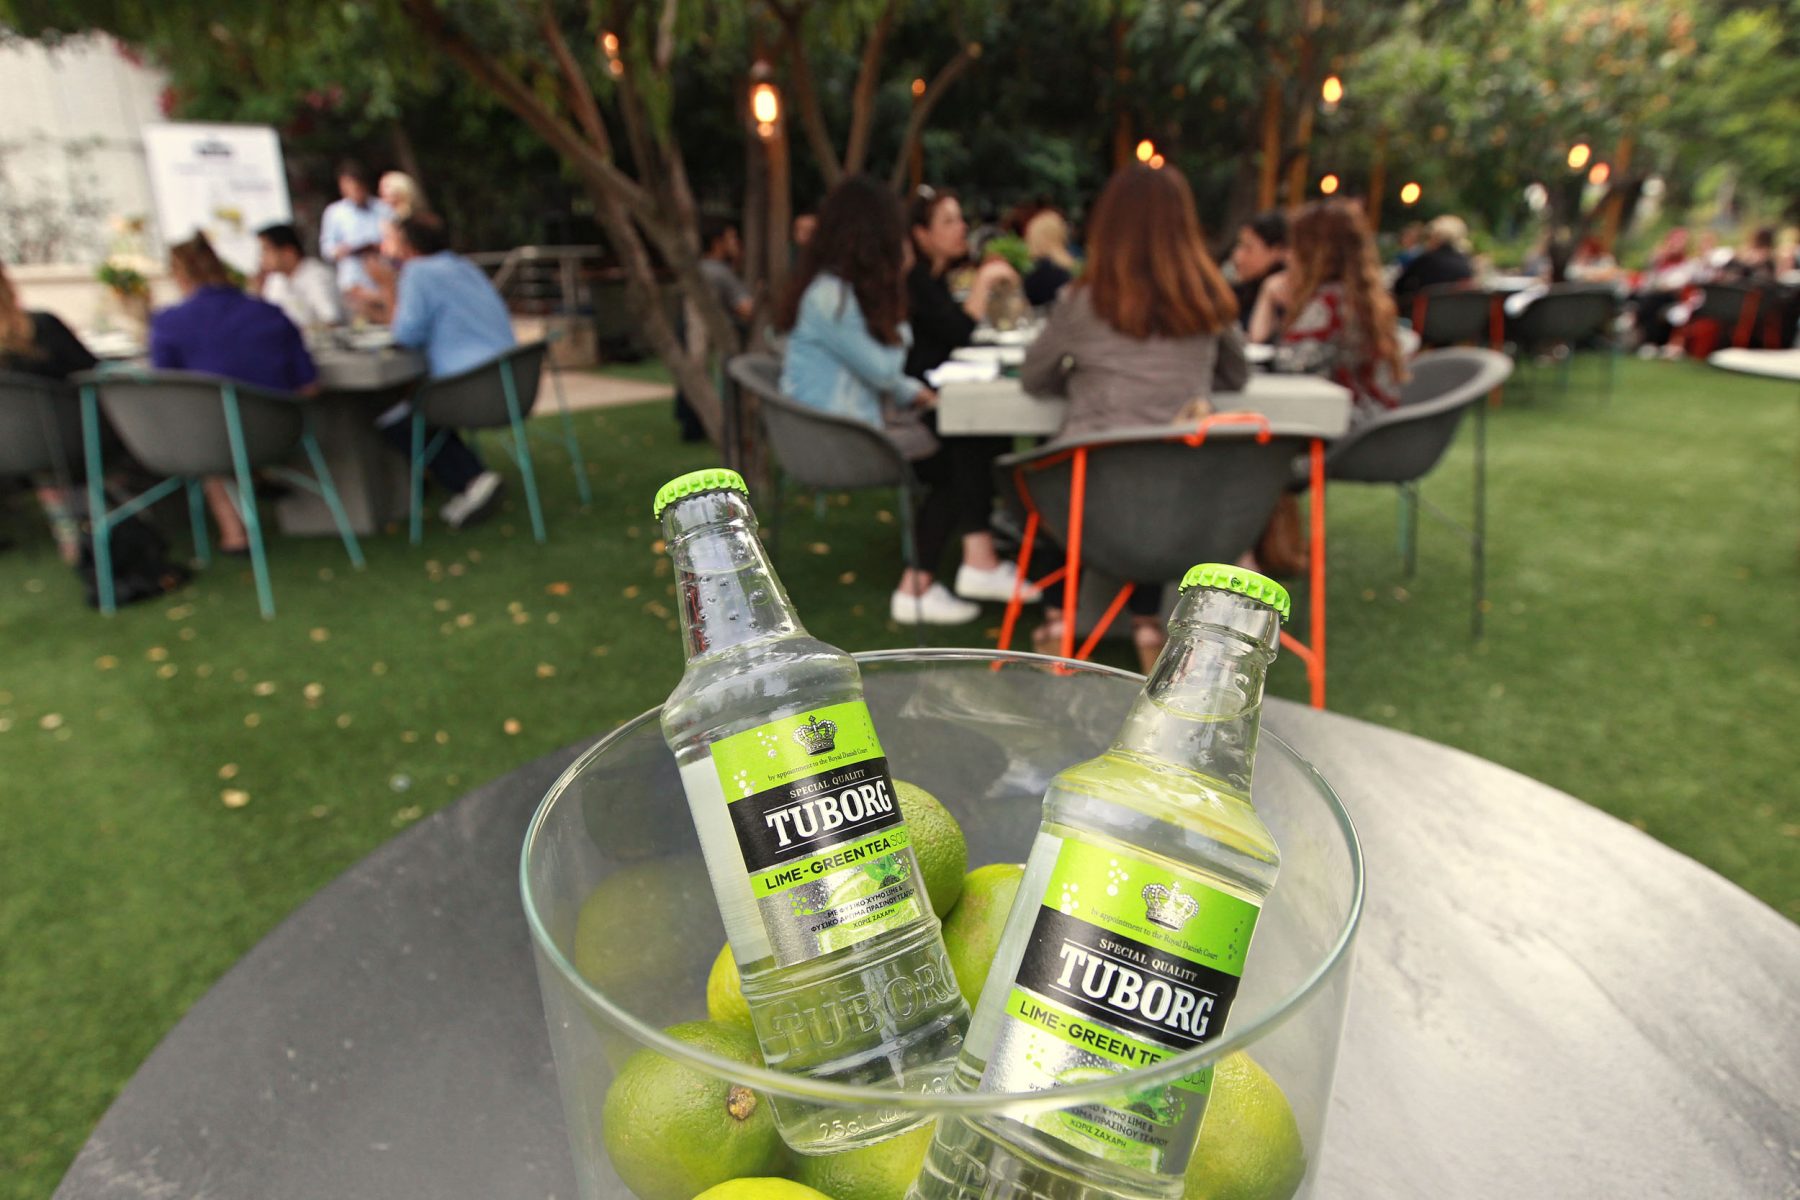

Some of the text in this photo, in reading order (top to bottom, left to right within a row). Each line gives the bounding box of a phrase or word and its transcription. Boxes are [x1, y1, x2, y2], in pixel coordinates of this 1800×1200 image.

[776, 765, 812, 779] appointment
[828, 753, 842, 762] Royal
[789, 768, 865, 799] SPECIAL QUALITY
[765, 780, 893, 848] TUBORG
[865, 837, 891, 855] TEA
[890, 831, 909, 847] SOD
[1099, 912, 1143, 933] appointment
[1151, 929, 1163, 939] the
[1164, 934, 1182, 946] Royal
[1182, 941, 1203, 954] Danish
[1098, 938, 1198, 981] SPECIAL QUALITY
[1056, 942, 1215, 1037] TUBORG
[1127, 1114, 1148, 1130] LIME
